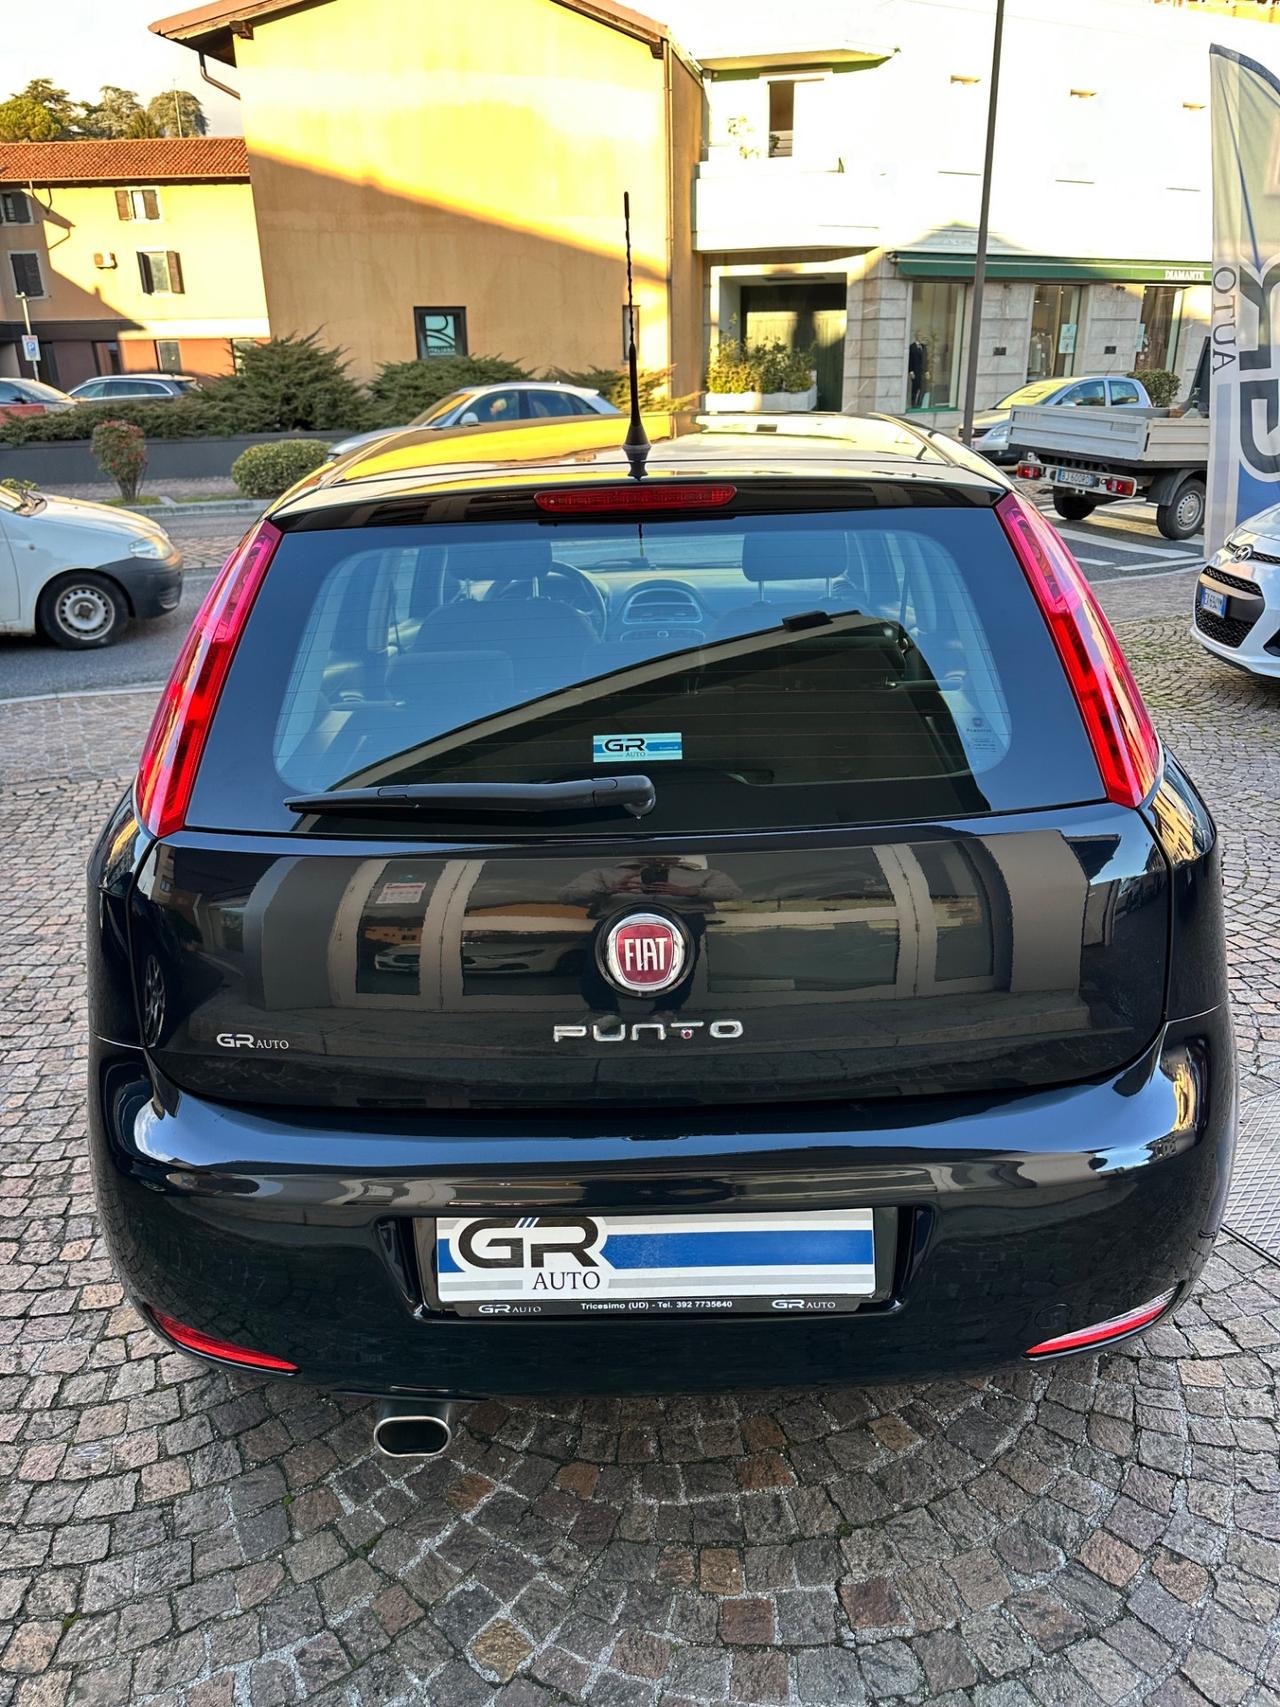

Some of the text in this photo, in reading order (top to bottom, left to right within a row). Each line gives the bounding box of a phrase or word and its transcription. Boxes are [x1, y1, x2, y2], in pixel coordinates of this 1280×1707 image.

[1164, 269, 1205, 281] DIAMANTE
[604, 738, 646, 752] GR
[623, 937, 668, 972] FIAT
[553, 1020, 744, 1043] PUNTO
[216, 1033, 290, 1050] GR AUTO
[458, 1216, 600, 1269] GR
[532, 1270, 601, 1290] AUTO
[478, 1303, 542, 1314] GR AUTO
[580, 1302, 626, 1310] Tricesimo
[628, 1301, 650, 1311] (UD)
[657, 1301, 673, 1309] Tel.
[676, 1300, 693, 1309] 392
[694, 1300, 734, 1309] 7735640
[771, 1298, 836, 1309] GR AUTO
